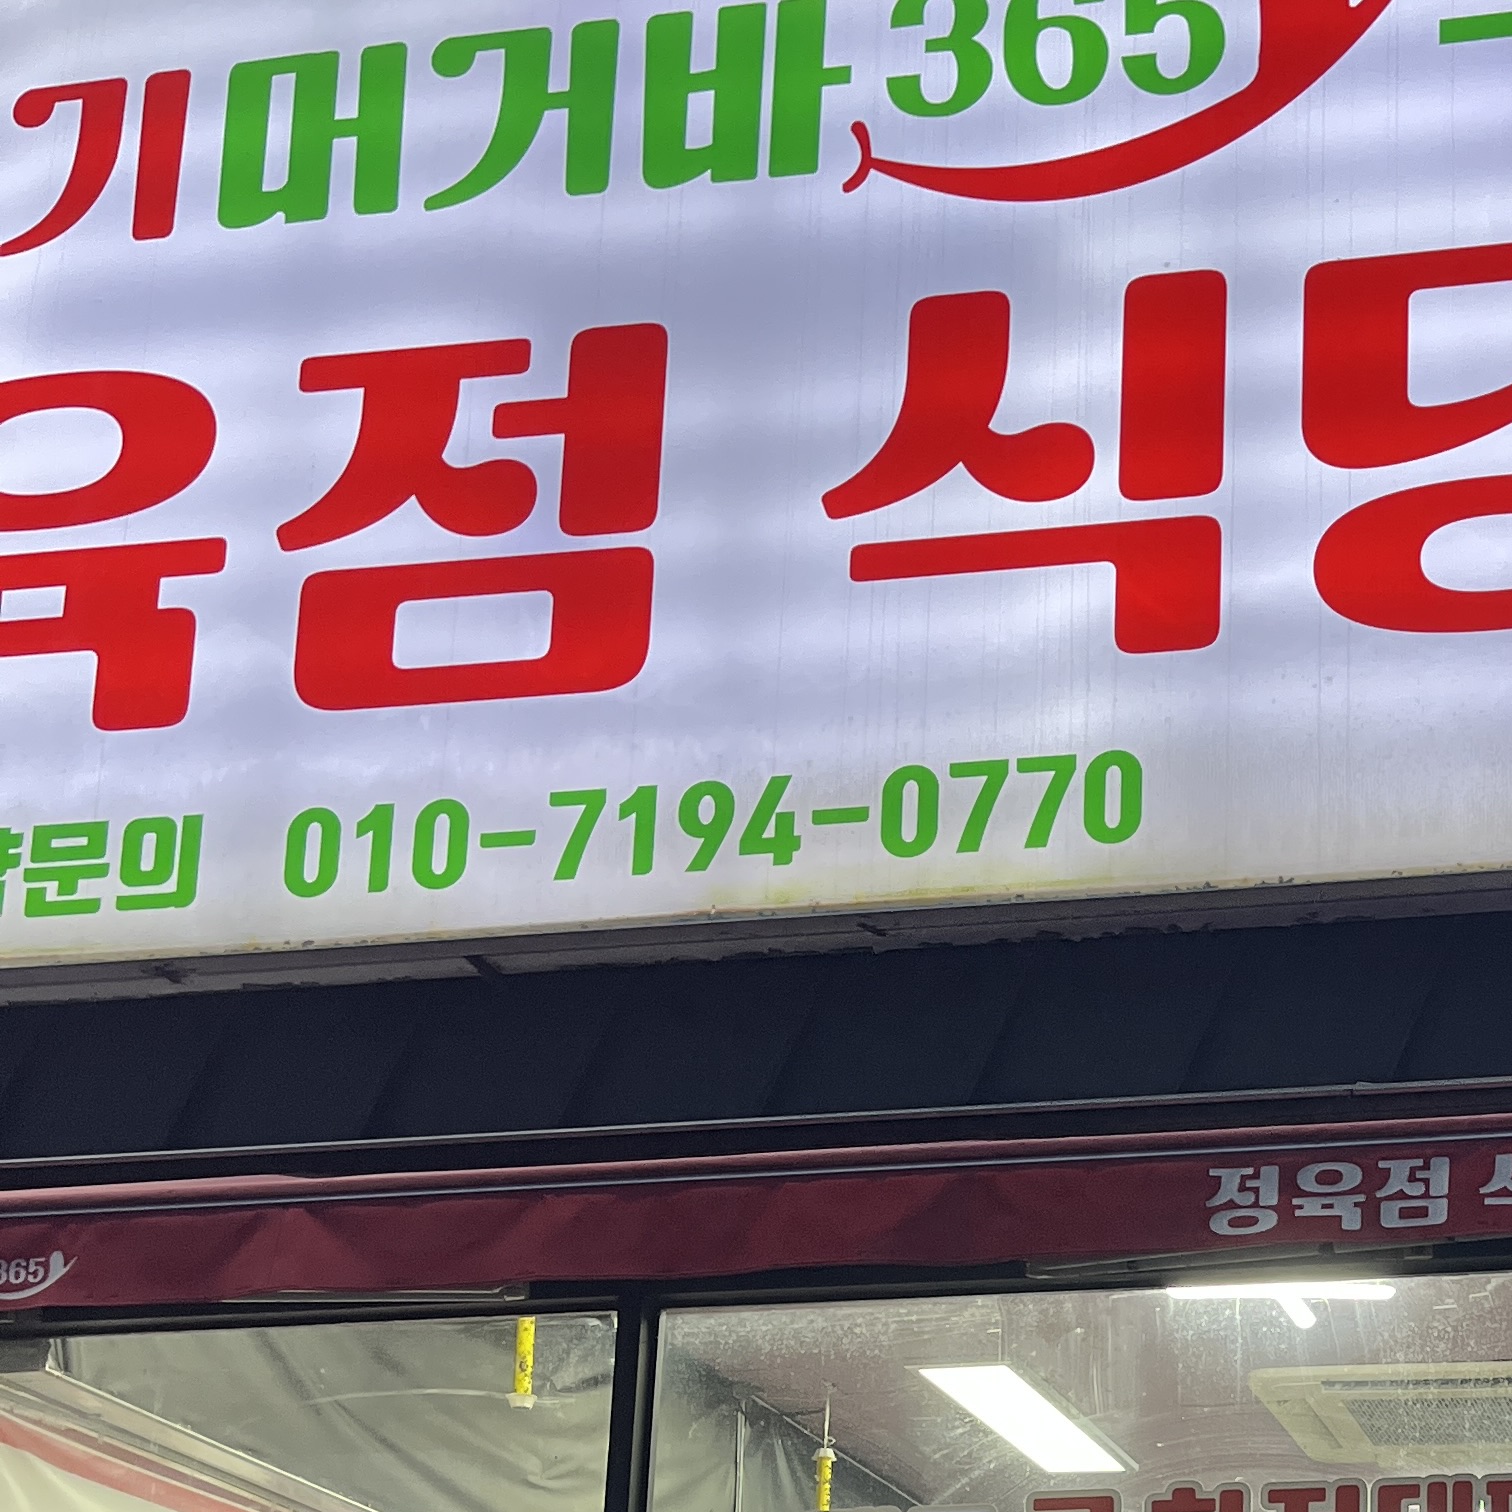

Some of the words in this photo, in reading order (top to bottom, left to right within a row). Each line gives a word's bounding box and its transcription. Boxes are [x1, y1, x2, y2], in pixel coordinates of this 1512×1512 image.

[0, 813, 204, 918] 문의
[284, 750, 1143, 897] 010-7194-0770
[1205, 1157, 1450, 1236] 정육점
